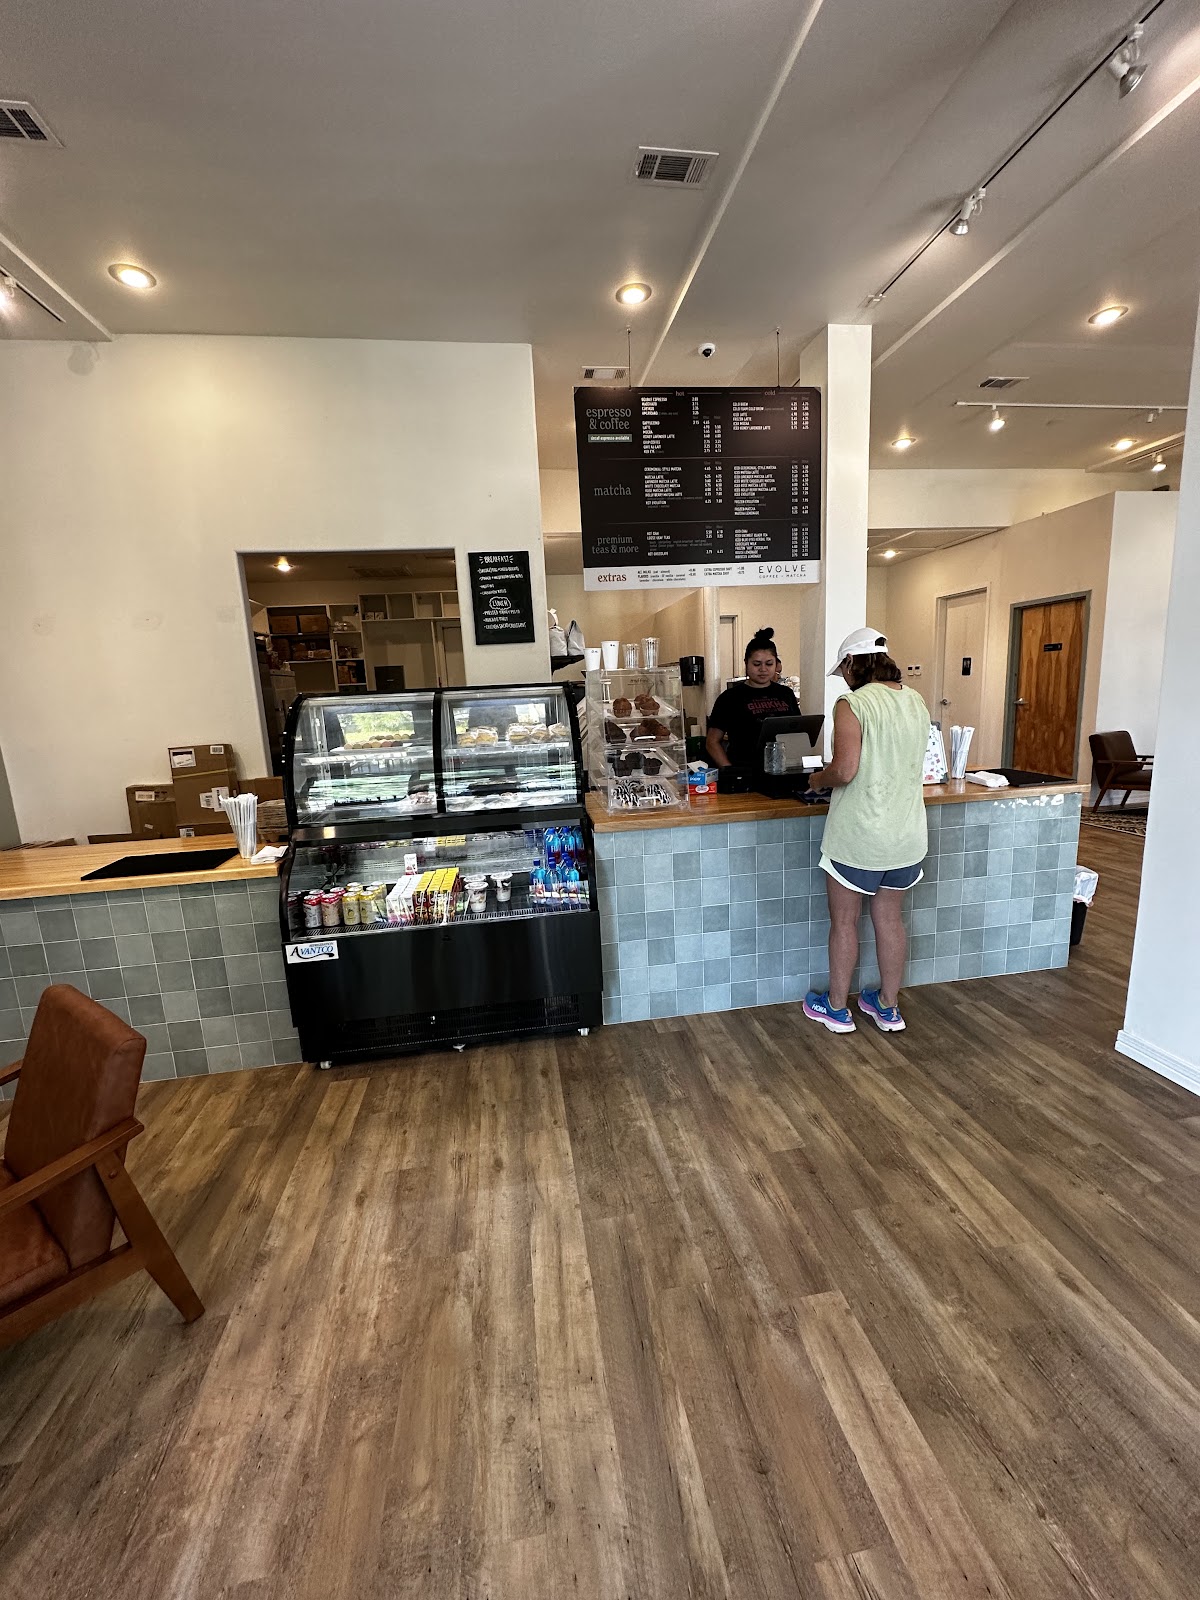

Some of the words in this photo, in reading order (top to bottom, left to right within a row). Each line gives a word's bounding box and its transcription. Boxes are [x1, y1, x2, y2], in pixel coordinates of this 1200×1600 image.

[586, 407, 632, 419] espresso
[589, 418, 598, 430] &
[599, 417, 630, 430] coffee
[593, 484, 632, 497] matcha
[597, 535, 633, 546] premium
[591, 545, 610, 554] teas
[610, 544, 618, 554] &
[618, 545, 639, 553] more
[758, 564, 807, 574] EVOLVE
[597, 572, 627, 583] extras
[747, 700, 790, 711] GURKHA
[290, 945, 334, 959] AVANTCO
[812, 1003, 827, 1015] HOKA
